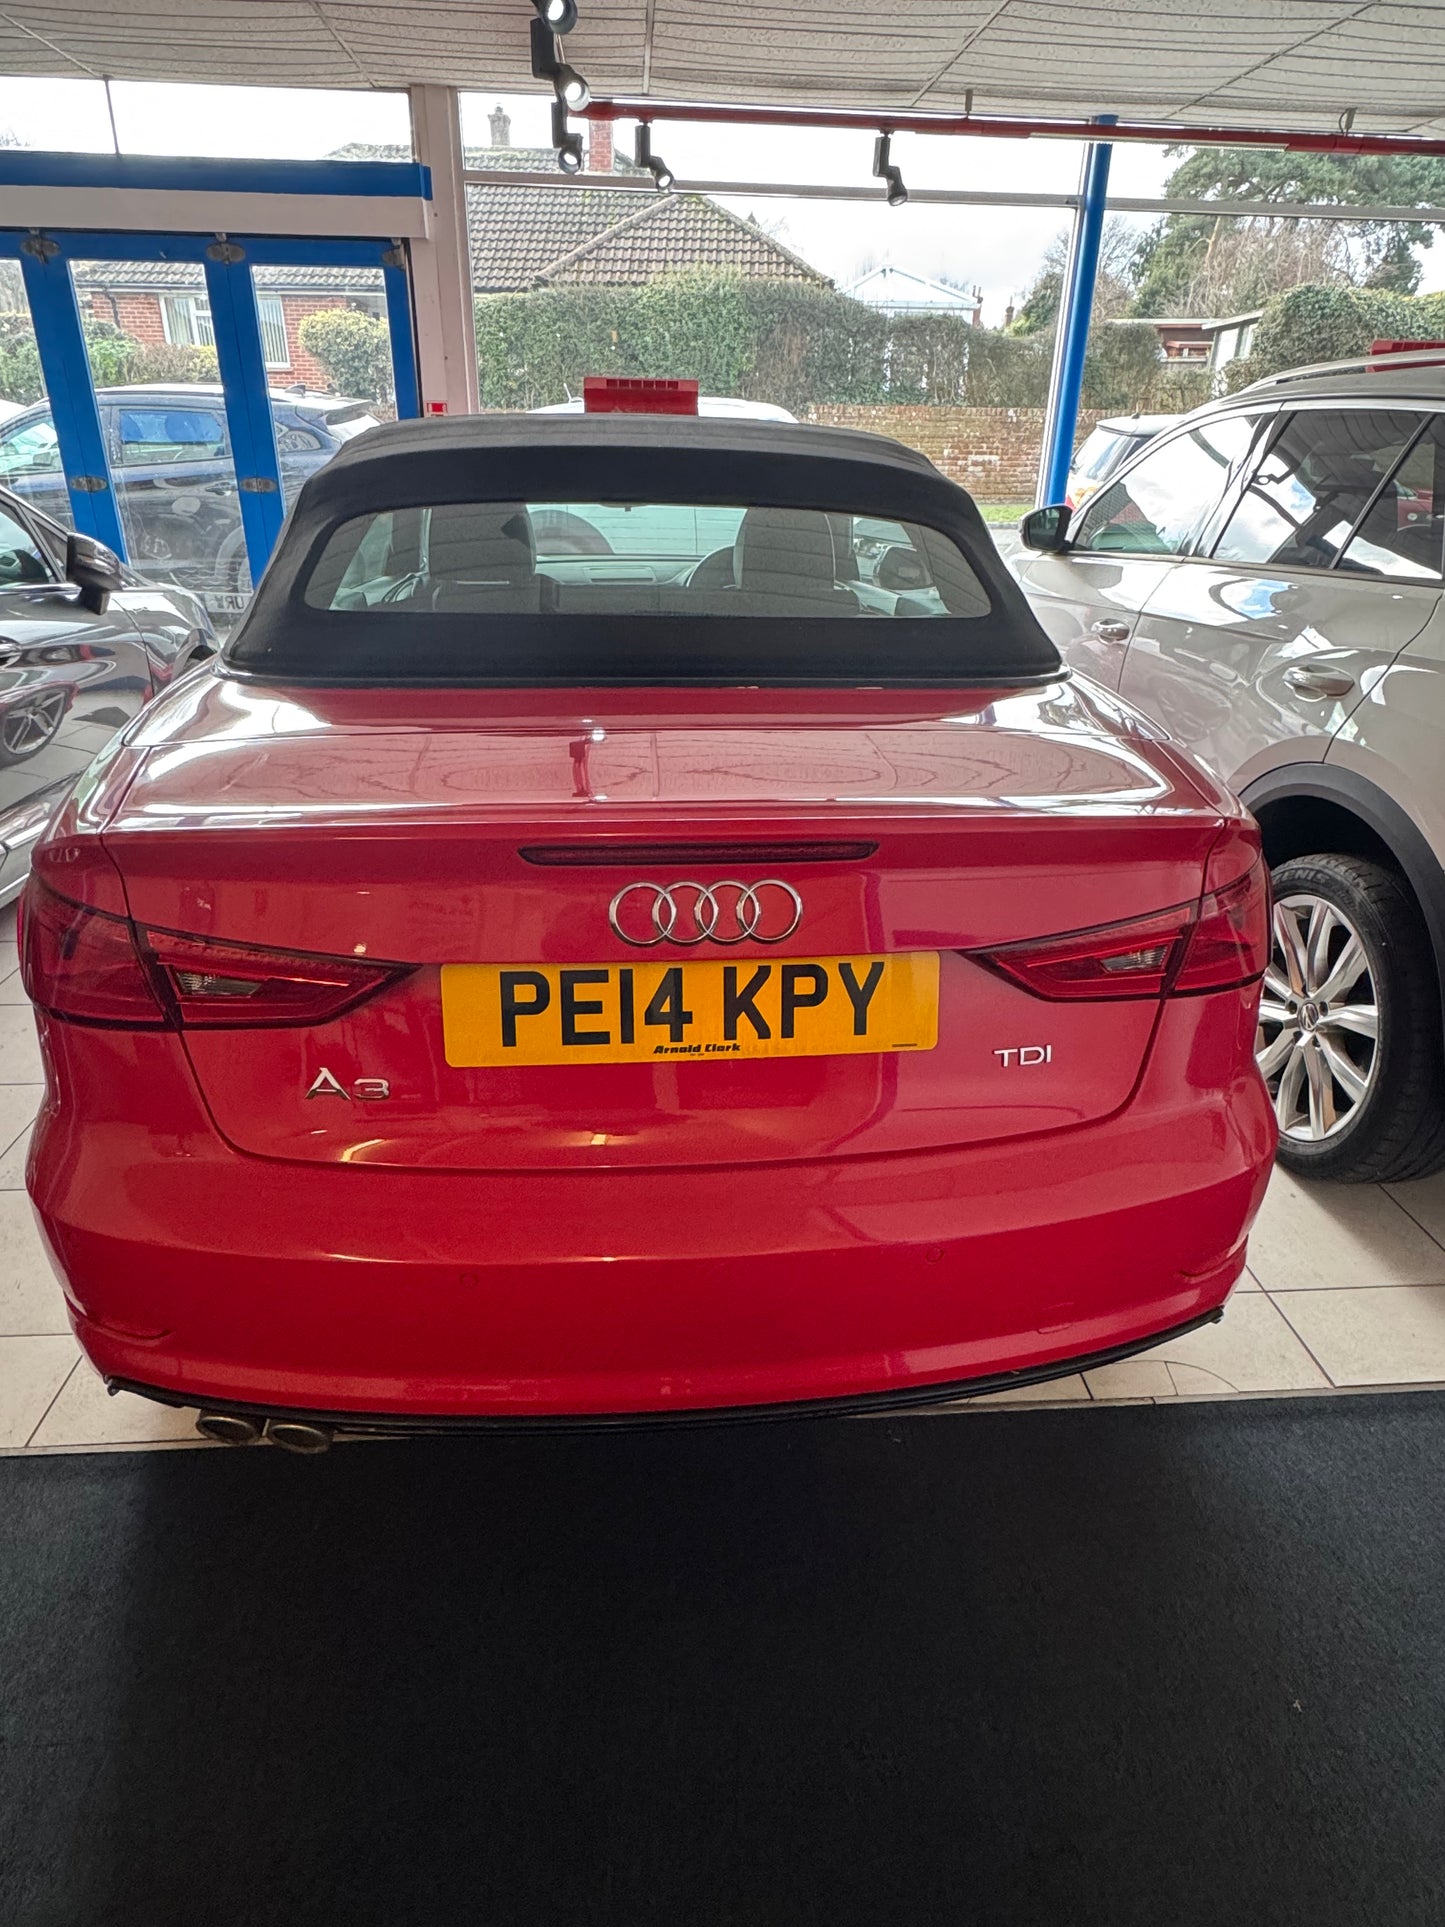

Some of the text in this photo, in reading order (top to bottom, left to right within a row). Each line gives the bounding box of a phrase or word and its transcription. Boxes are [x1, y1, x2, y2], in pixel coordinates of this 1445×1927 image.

[499, 961, 885, 1047] PE14 KPY
[653, 1043, 741, 1053] Arnold Clark
[992, 1043, 1052, 1067] TDI
[304, 1067, 390, 1101] A3
